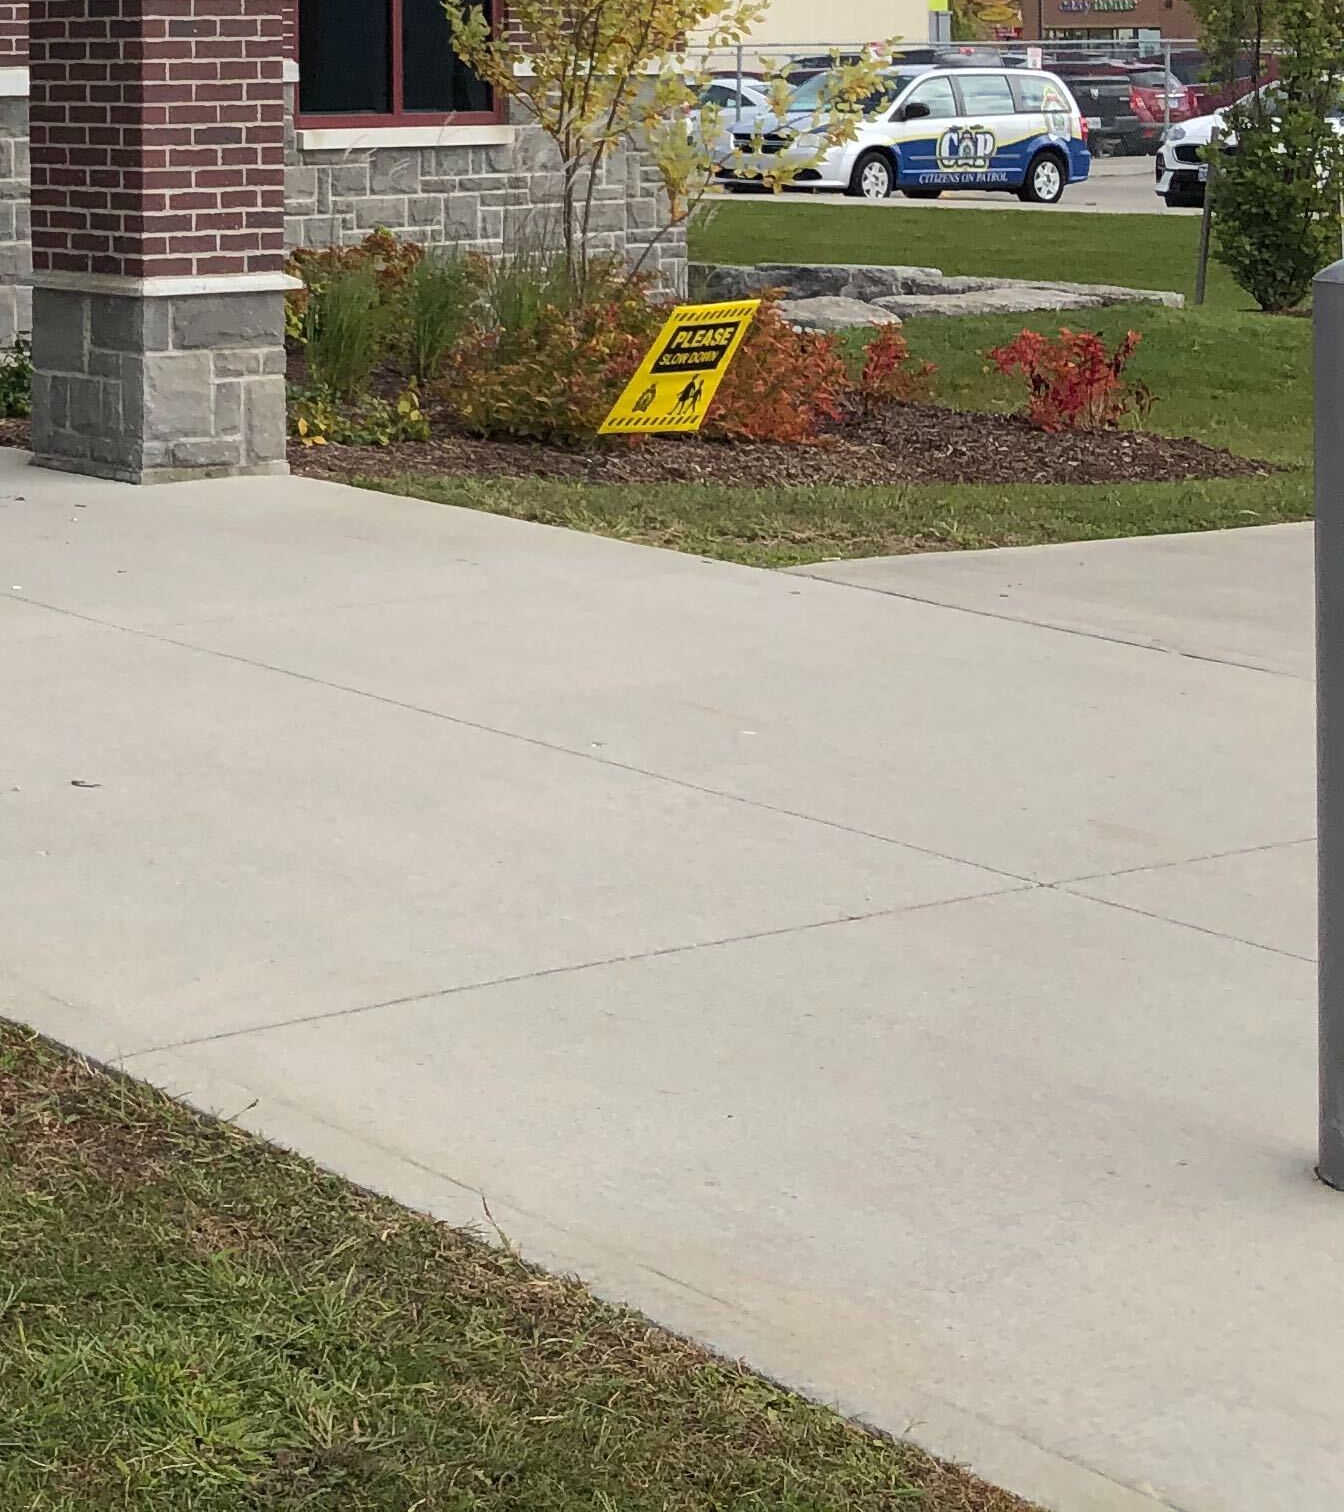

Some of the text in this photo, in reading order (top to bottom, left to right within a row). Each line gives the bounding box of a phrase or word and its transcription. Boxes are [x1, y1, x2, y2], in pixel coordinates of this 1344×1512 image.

[919, 171, 1008, 184] CITIZENS ON PATROL
[671, 327, 735, 348] PLEASE
[659, 353, 690, 365] SLOW
